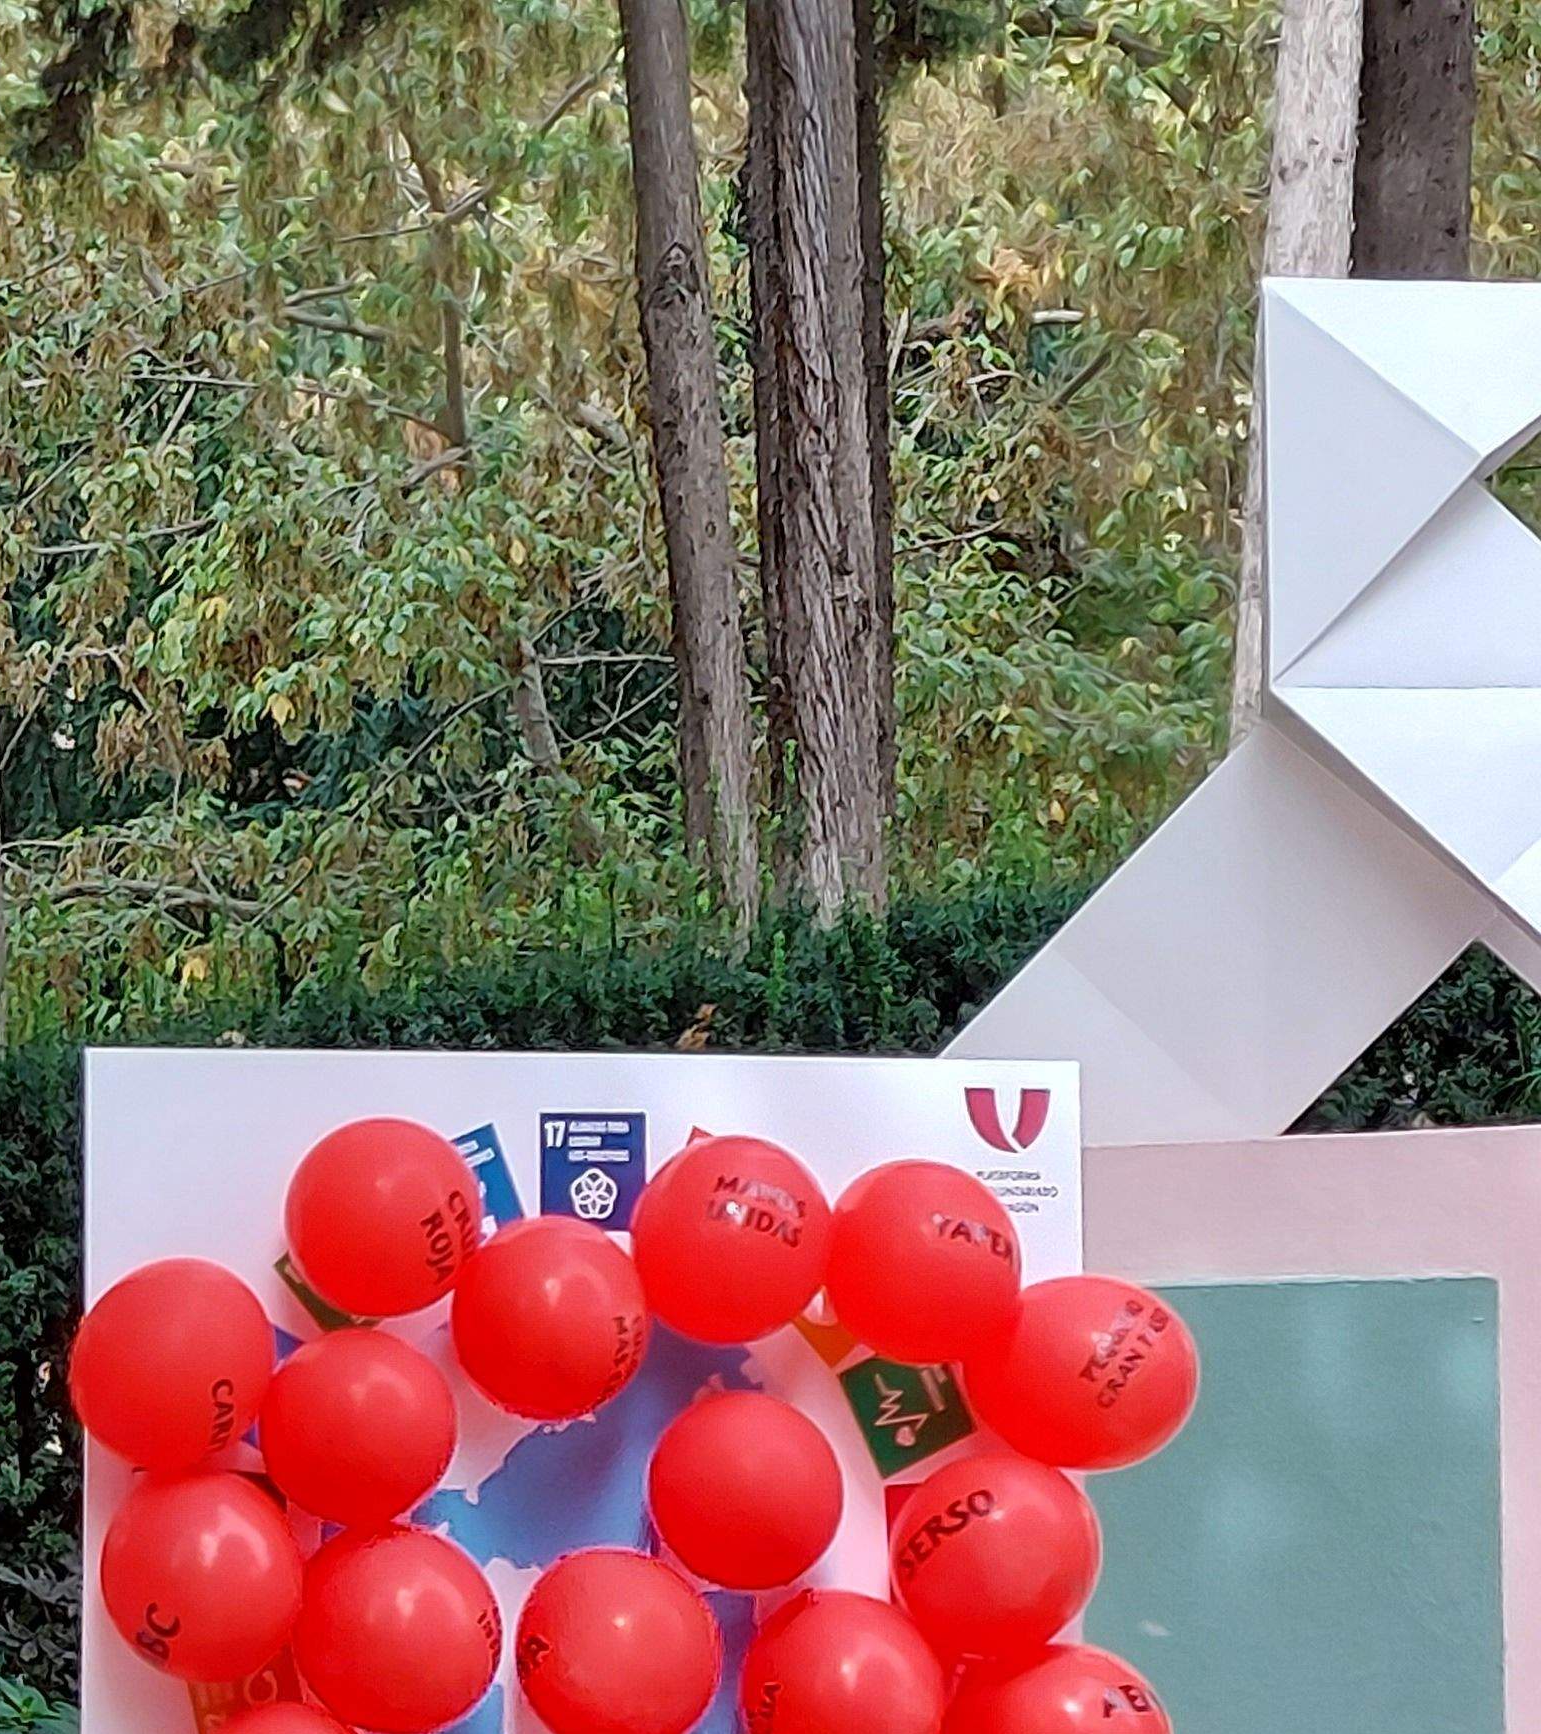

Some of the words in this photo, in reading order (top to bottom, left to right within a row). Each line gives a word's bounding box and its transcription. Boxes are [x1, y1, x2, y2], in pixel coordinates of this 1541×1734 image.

[543, 1120, 566, 1148] 17
[421, 1210, 456, 1286] ROJA
[898, 1489, 994, 1580] SERSO
